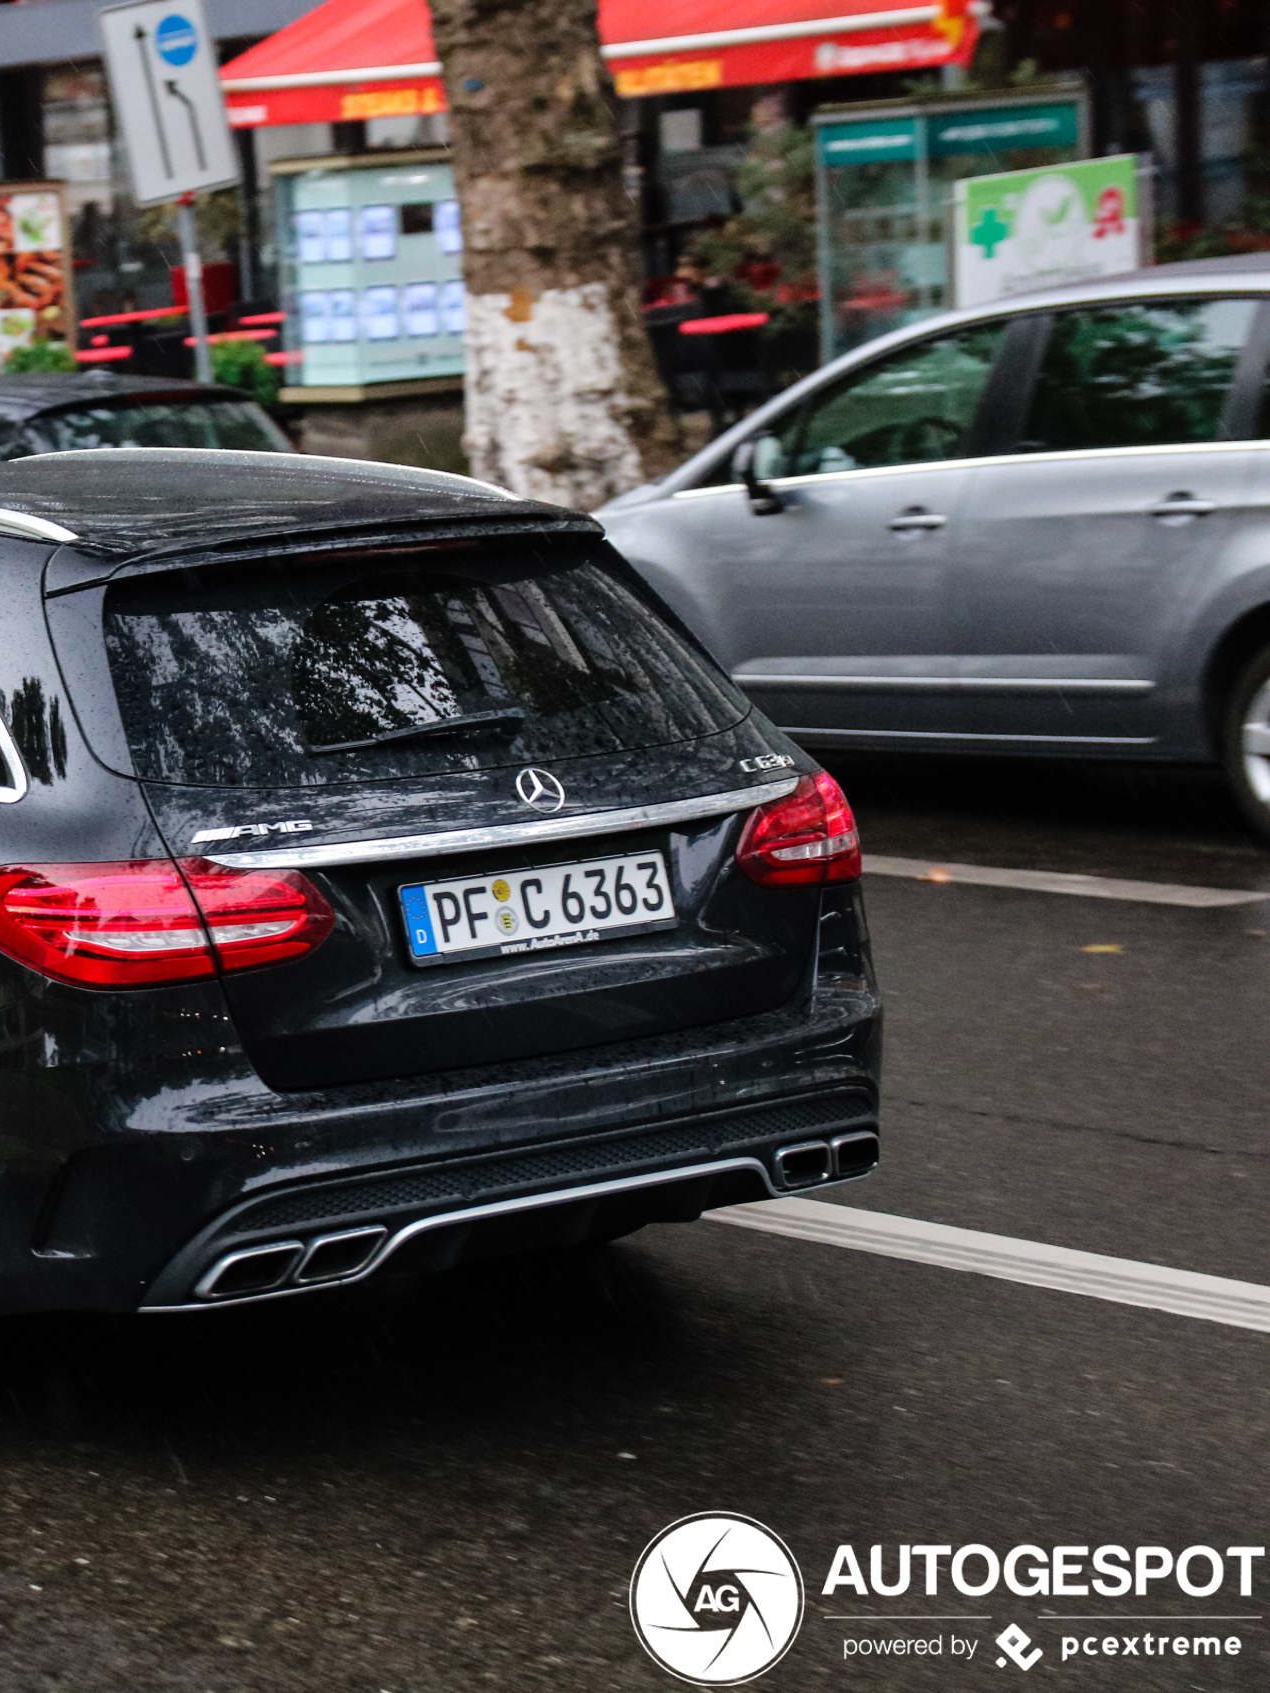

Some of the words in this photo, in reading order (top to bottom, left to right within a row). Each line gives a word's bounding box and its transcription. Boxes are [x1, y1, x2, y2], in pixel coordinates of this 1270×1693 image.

[230, 820, 314, 839] AMG
[433, 886, 489, 943] PF
[520, 878, 551, 930] C
[560, 861, 664, 925] 6363
[416, 929, 428, 944] D
